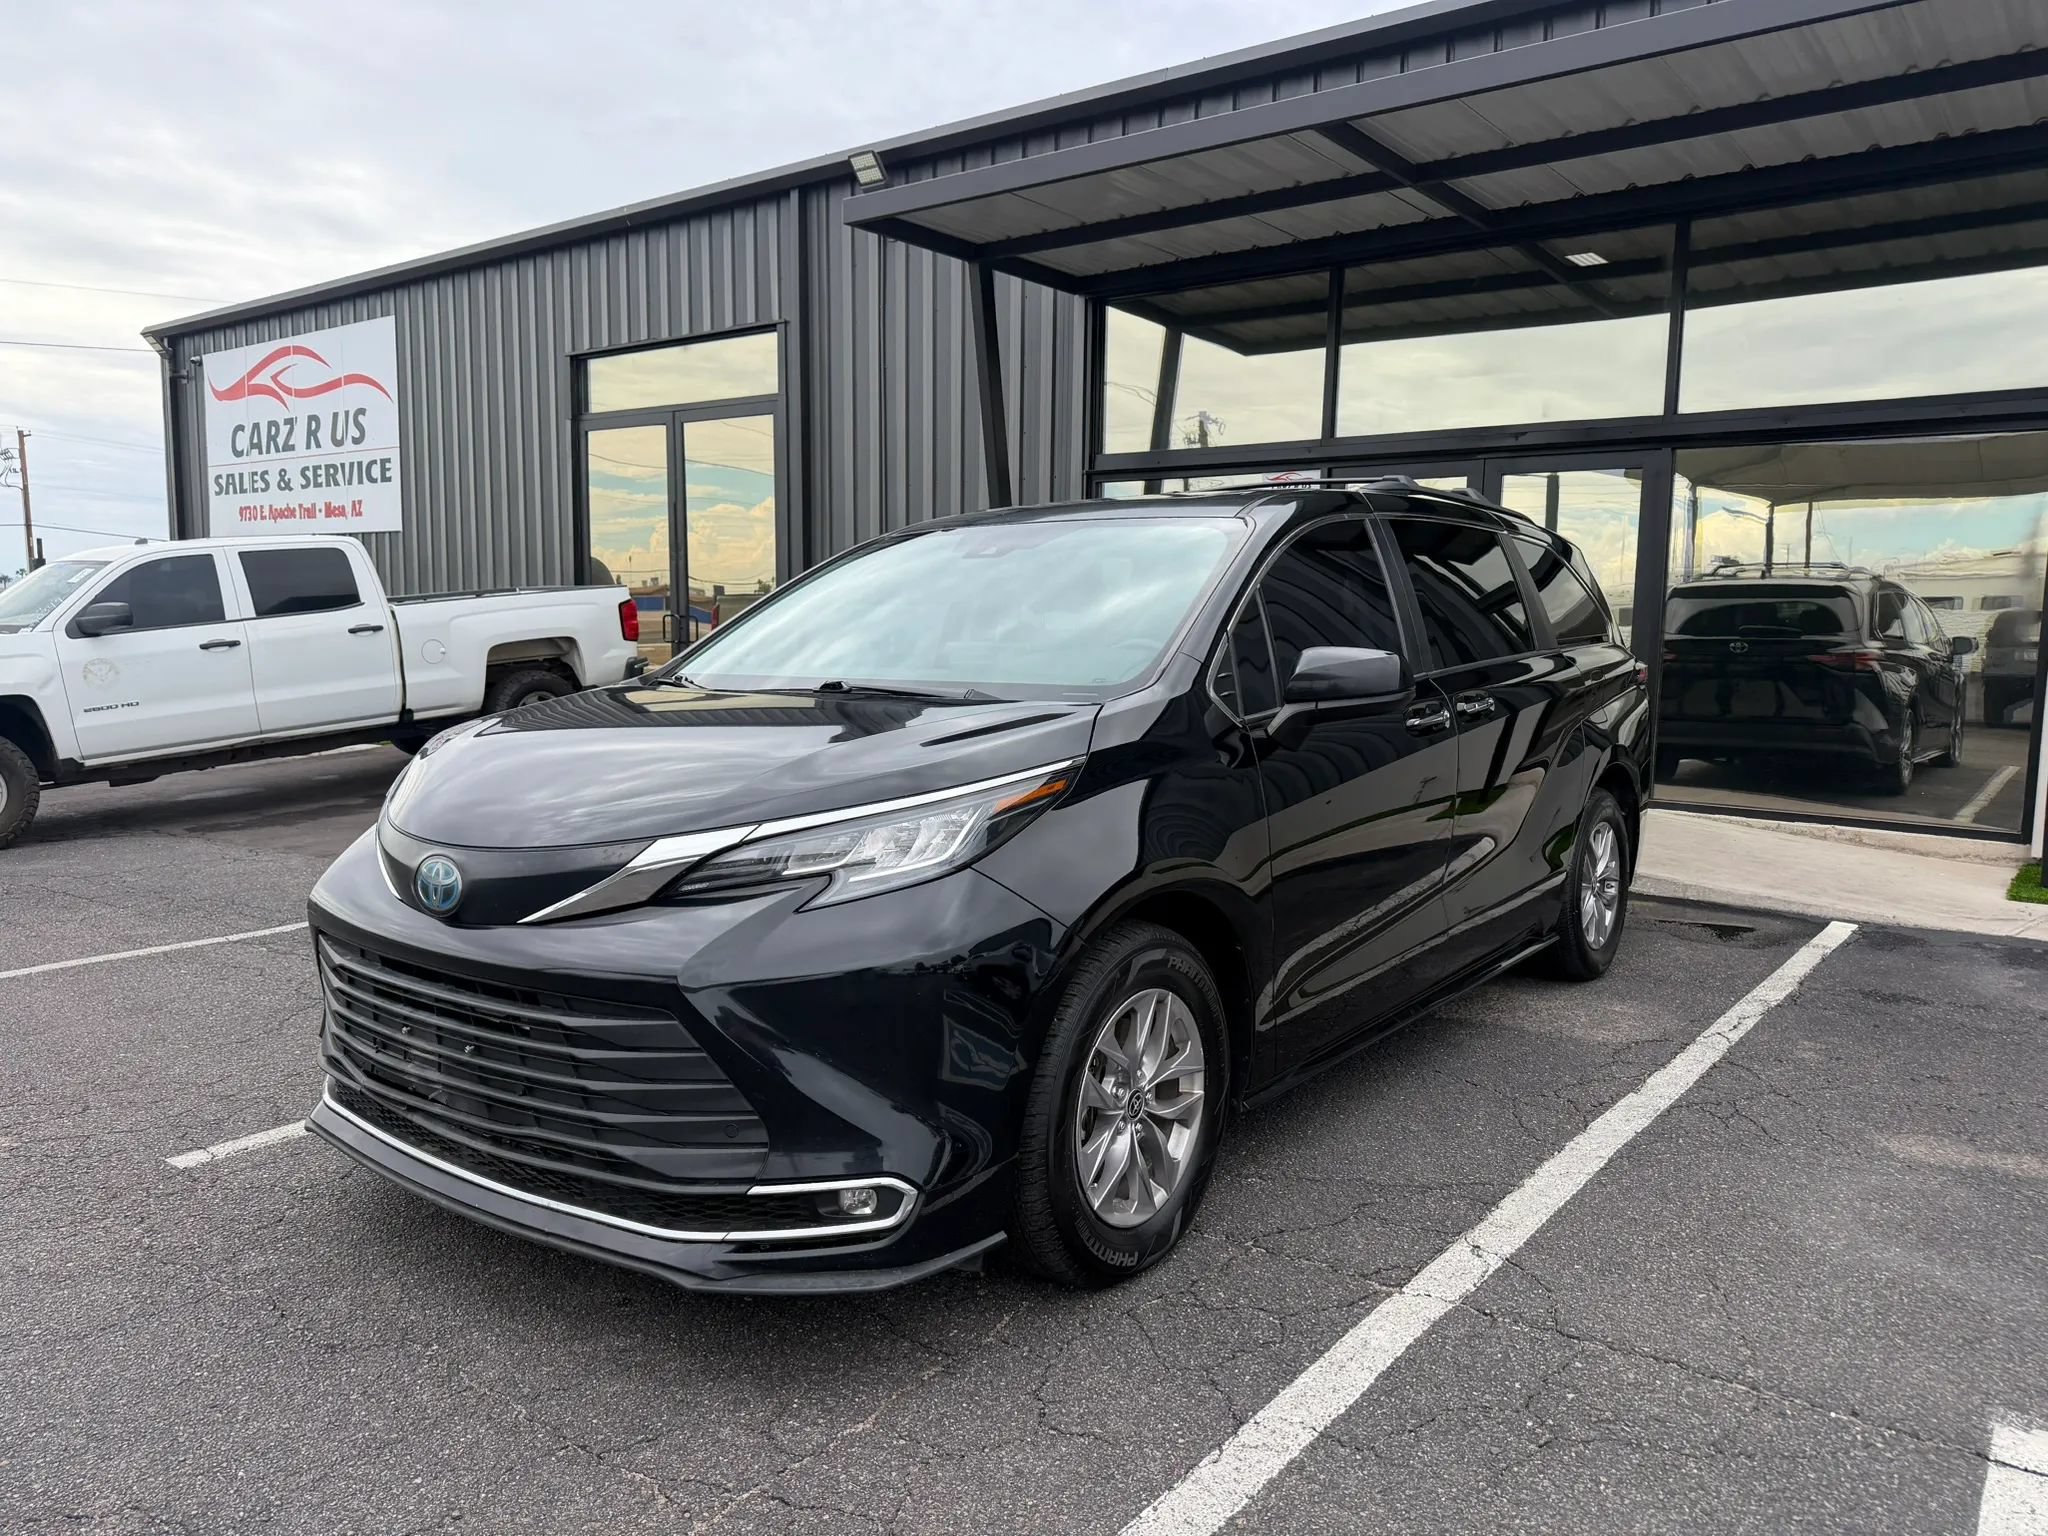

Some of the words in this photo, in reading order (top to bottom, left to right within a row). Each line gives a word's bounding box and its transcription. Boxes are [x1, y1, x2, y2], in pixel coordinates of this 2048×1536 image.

[305, 414, 322, 450] R
[330, 407, 367, 448] US
[214, 469, 270, 496] SALES
[277, 468, 294, 492] &
[300, 457, 392, 490] SERVICE
[239, 504, 258, 522] 9730
[268, 503, 297, 524] Apache
[298, 502, 317, 519] Trail
[351, 499, 363, 517] AZ
